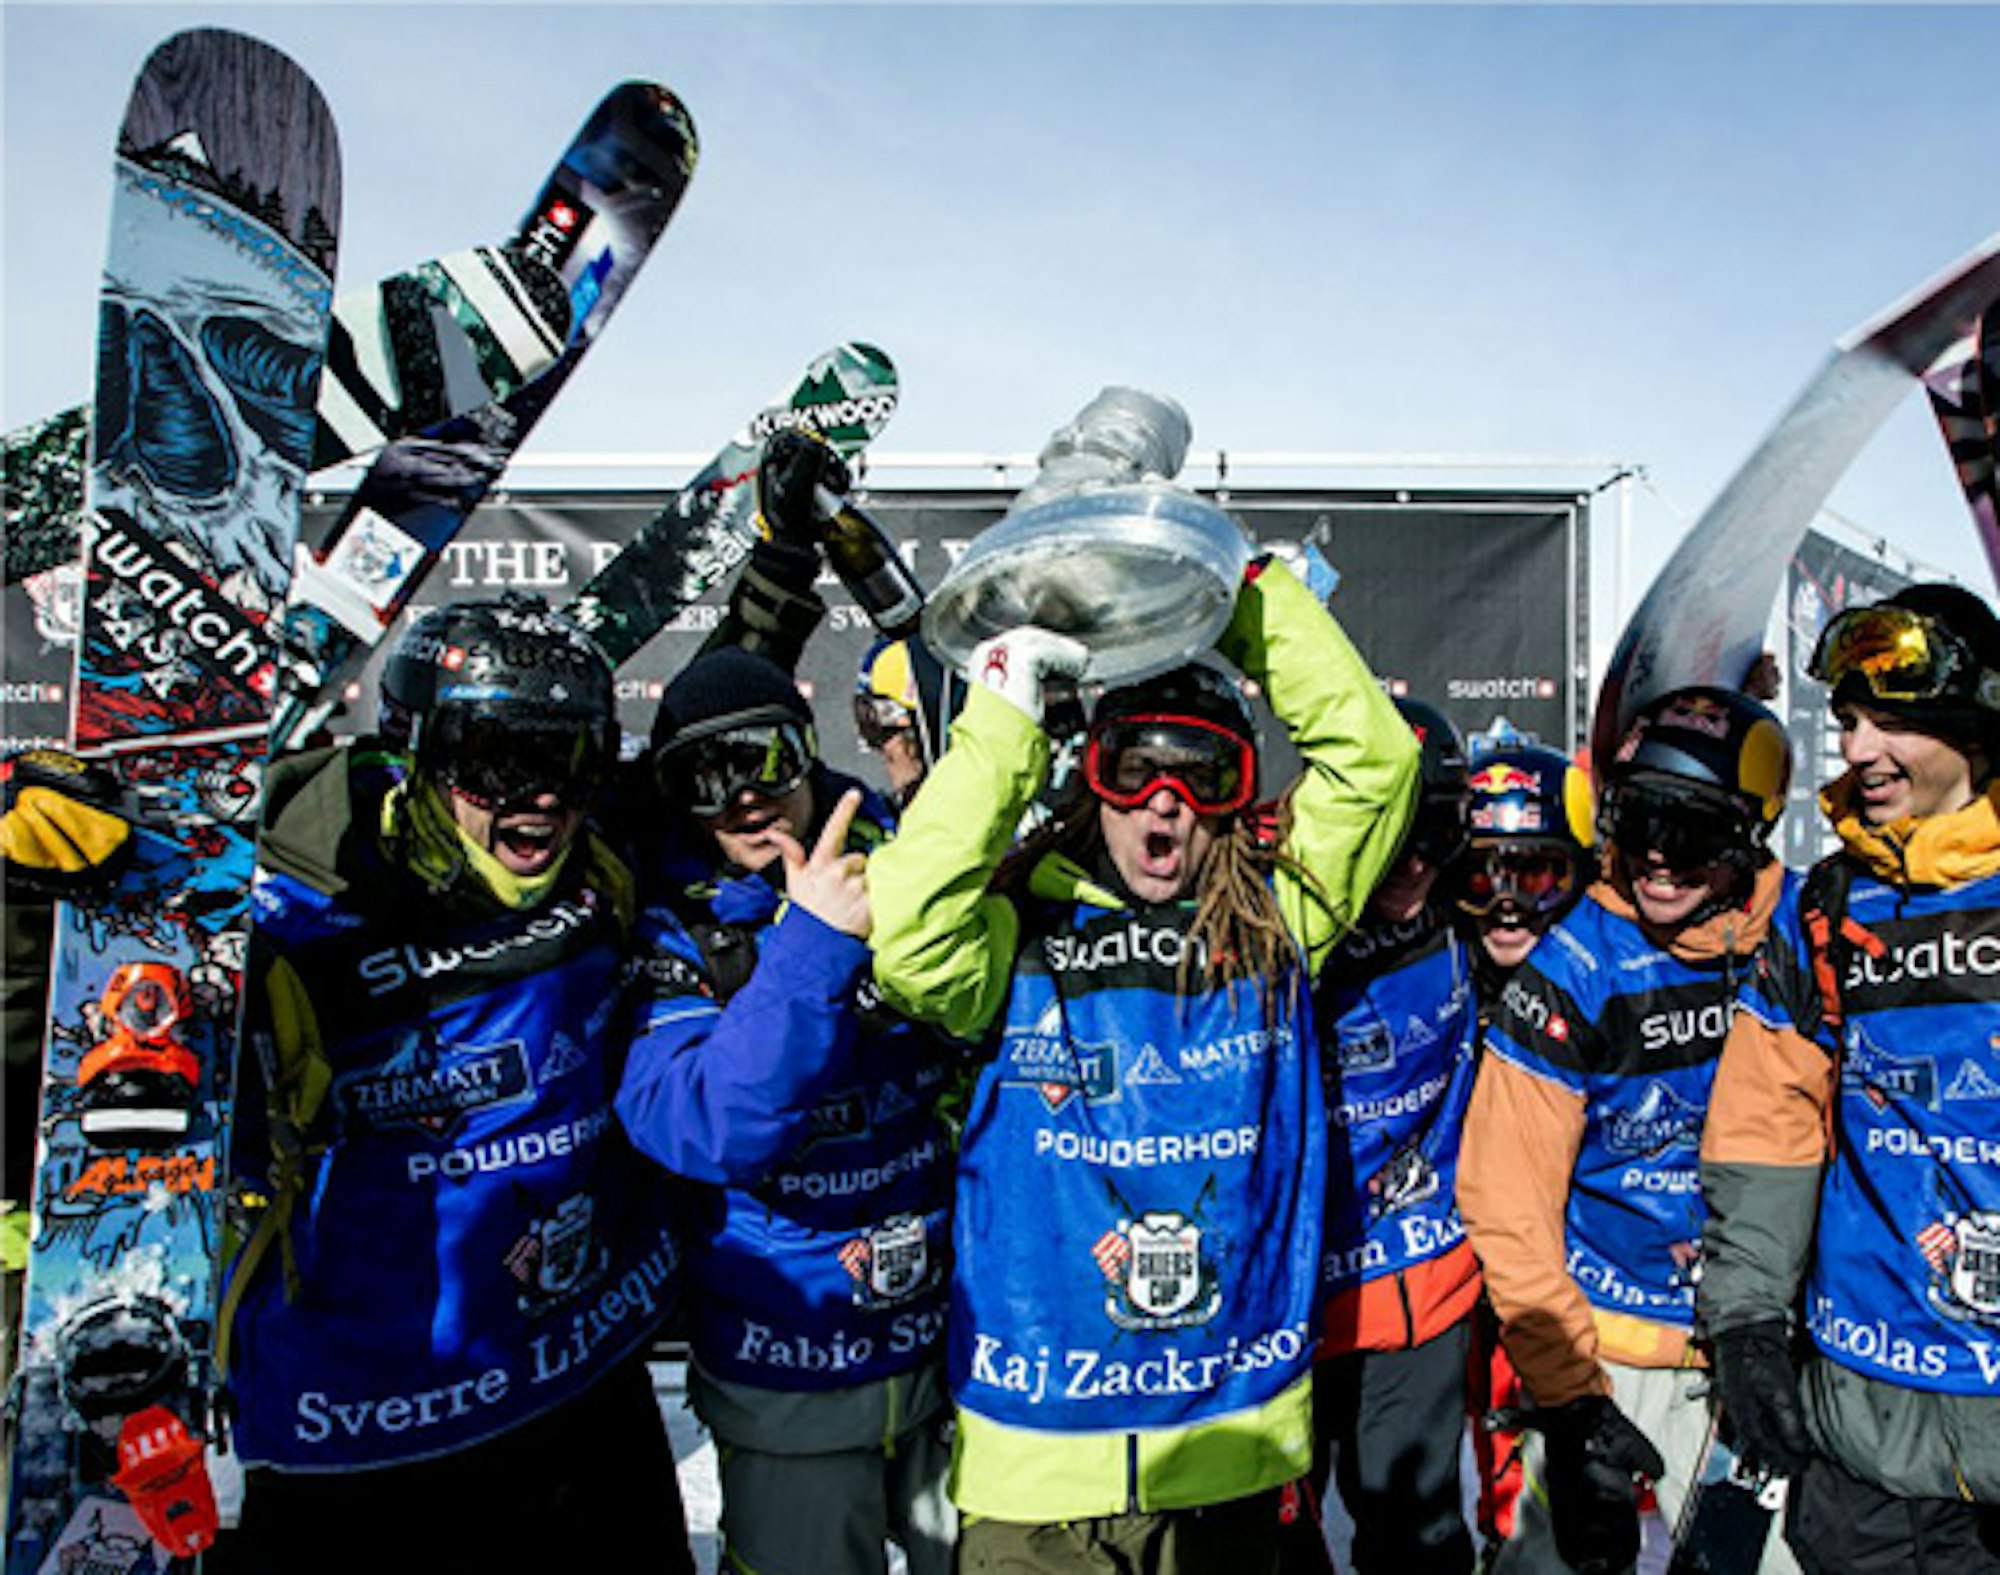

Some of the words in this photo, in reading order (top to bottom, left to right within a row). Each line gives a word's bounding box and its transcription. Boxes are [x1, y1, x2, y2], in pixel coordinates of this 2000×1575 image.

[443, 541, 569, 586] THE
[1447, 679, 1536, 699] swatch
[734, 1318, 873, 1372] Fabio
[971, 1333, 1050, 1404] Kaj
[296, 1368, 510, 1443] Sverre
